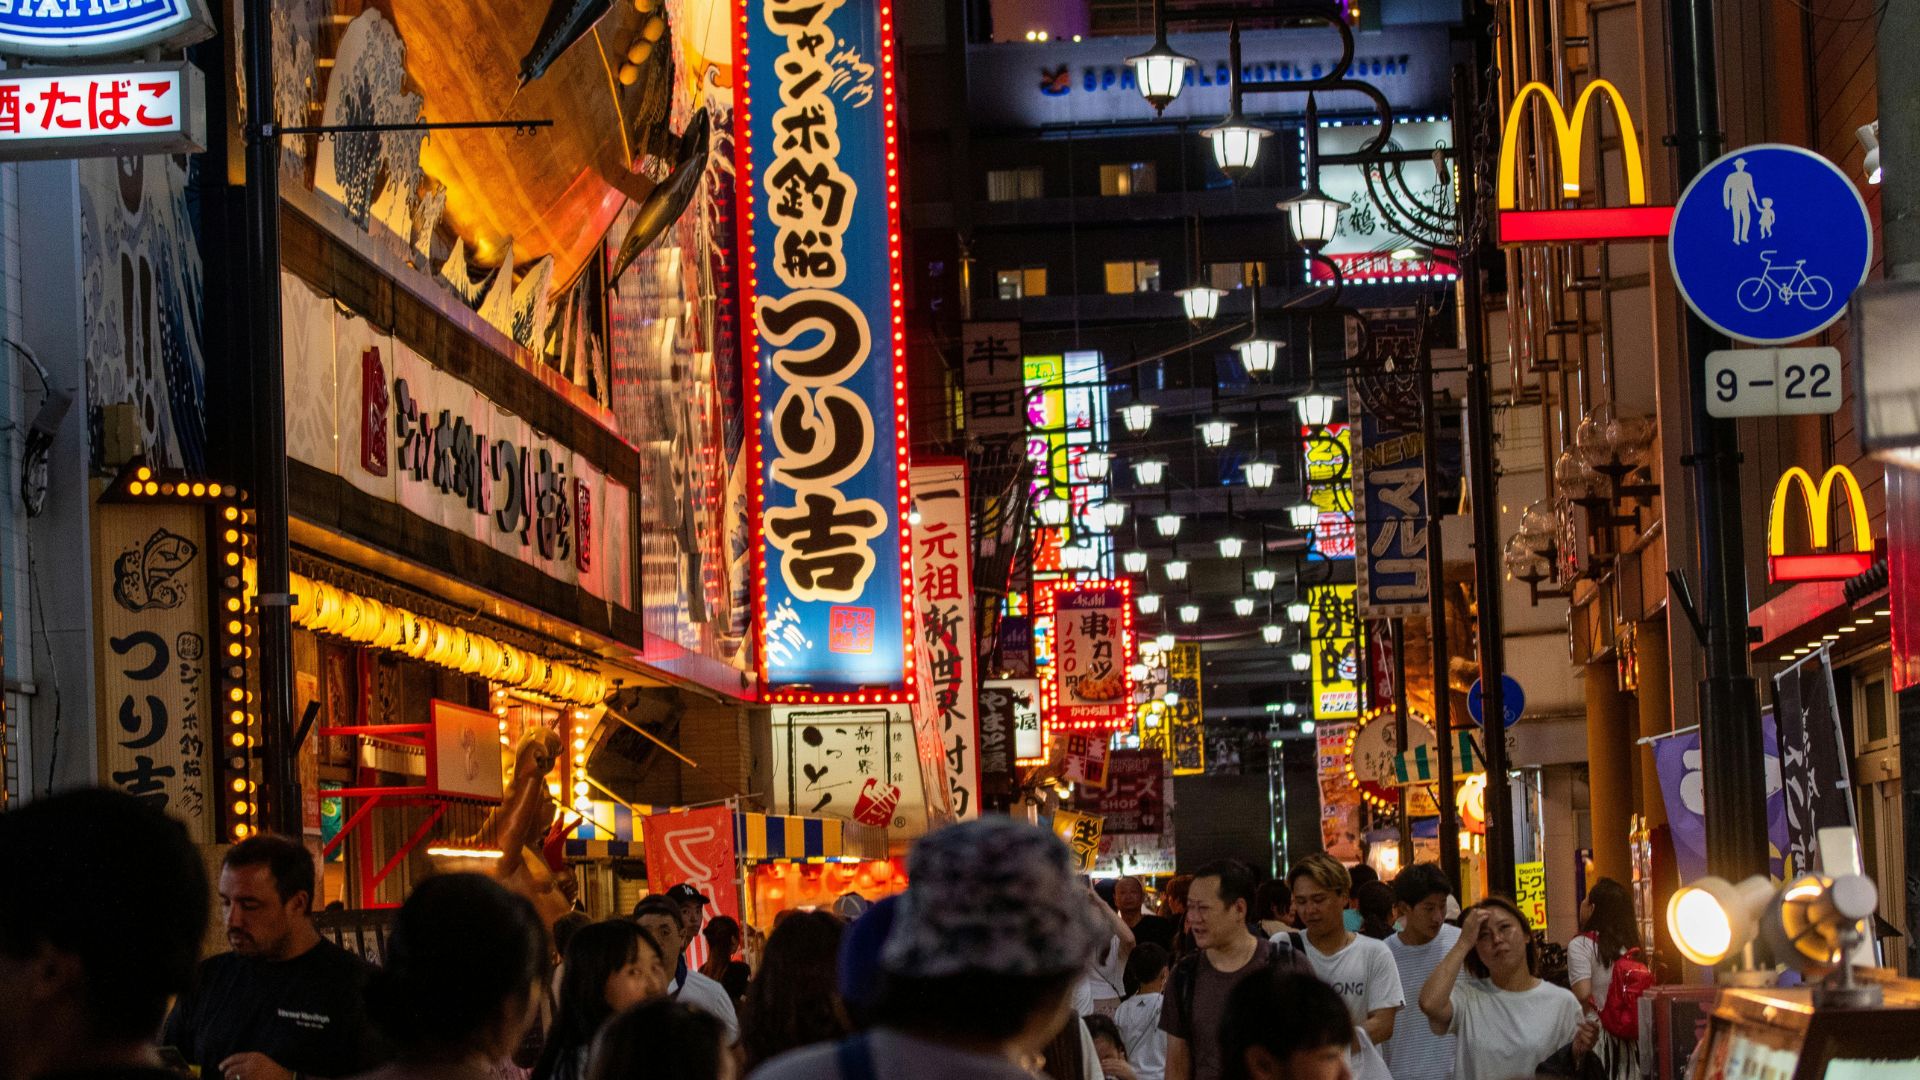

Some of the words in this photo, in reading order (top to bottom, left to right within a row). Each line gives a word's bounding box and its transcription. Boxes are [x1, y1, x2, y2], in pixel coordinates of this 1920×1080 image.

[1364, 433, 1424, 466] NEW
[1080, 611, 1113, 680] 串カツ
